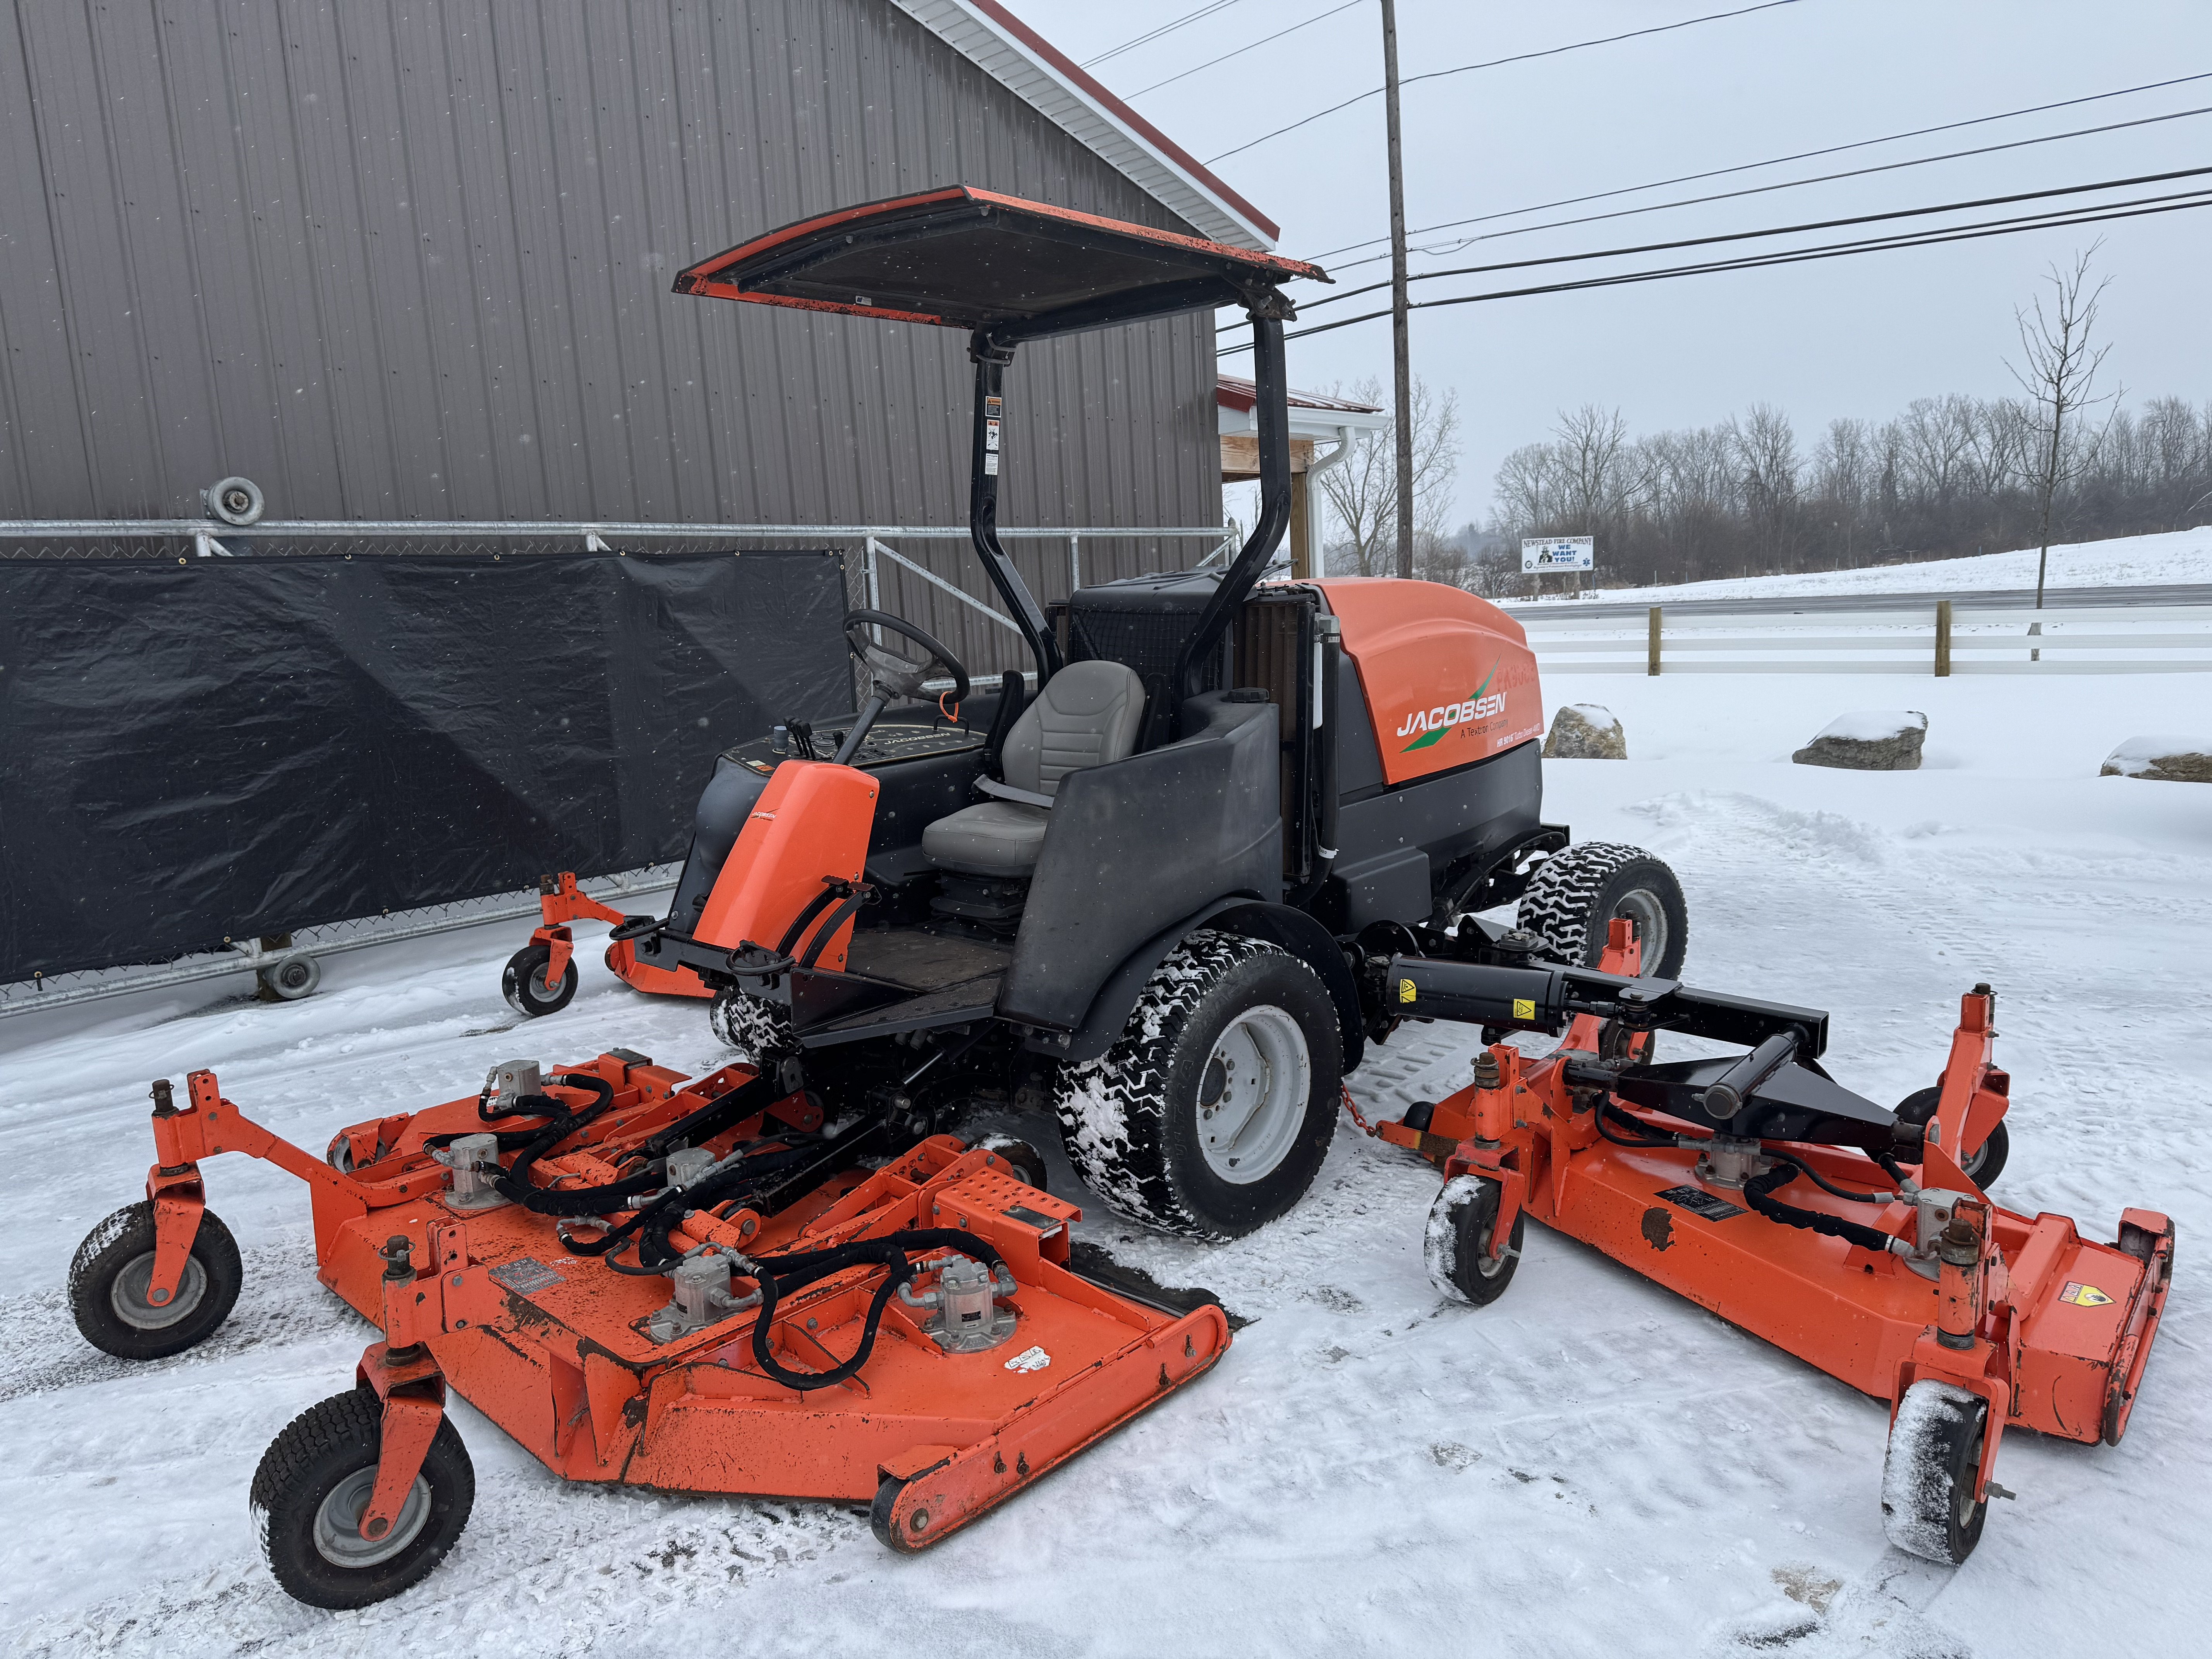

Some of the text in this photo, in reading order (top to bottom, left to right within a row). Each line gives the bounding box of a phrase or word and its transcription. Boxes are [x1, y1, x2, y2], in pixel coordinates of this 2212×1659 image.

[1523, 539, 1553, 548] NEWSTEAD
[1397, 692, 1506, 737] JACOBSEN
[884, 732, 950, 744] JACOBSEN
[1461, 719, 1508, 738] A Textron Company
[1497, 738, 1503, 748] HR
[1515, 732, 1523, 740] Turbo
[1523, 727, 1532, 737] Diesel
